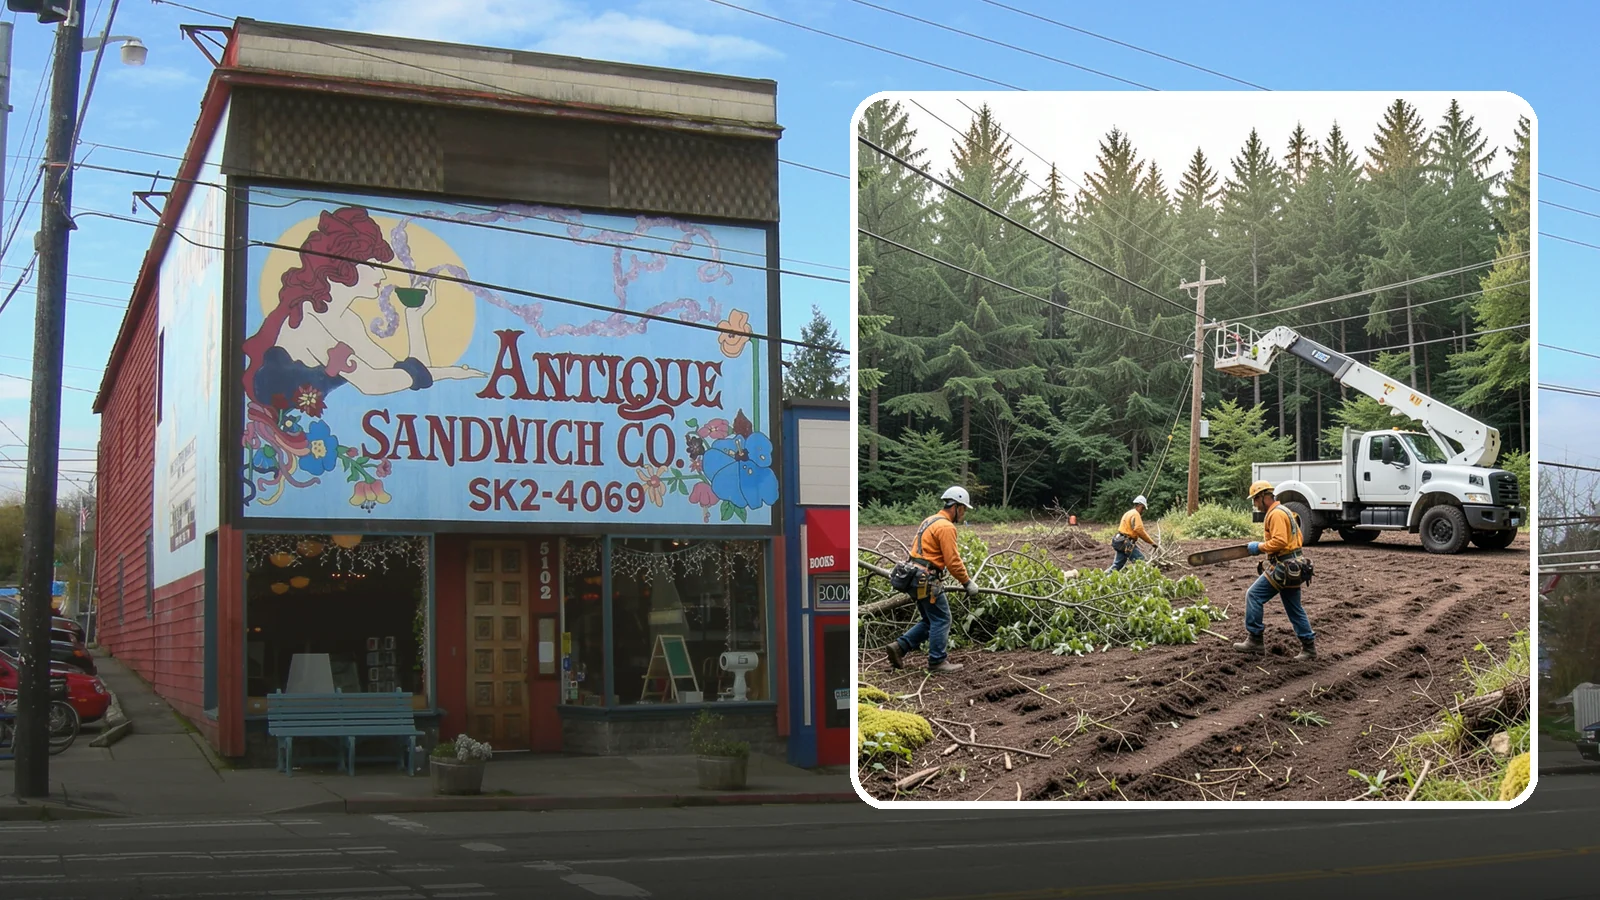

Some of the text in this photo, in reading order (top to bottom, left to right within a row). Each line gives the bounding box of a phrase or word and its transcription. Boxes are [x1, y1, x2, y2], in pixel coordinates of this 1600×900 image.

[475, 329, 723, 420] ANTIQUE
[361, 408, 685, 469] SANDWICH CO.
[468, 477, 645, 513] SK2-4069
[540, 542, 551, 599] 5102
[809, 555, 835, 569] BOOKS
